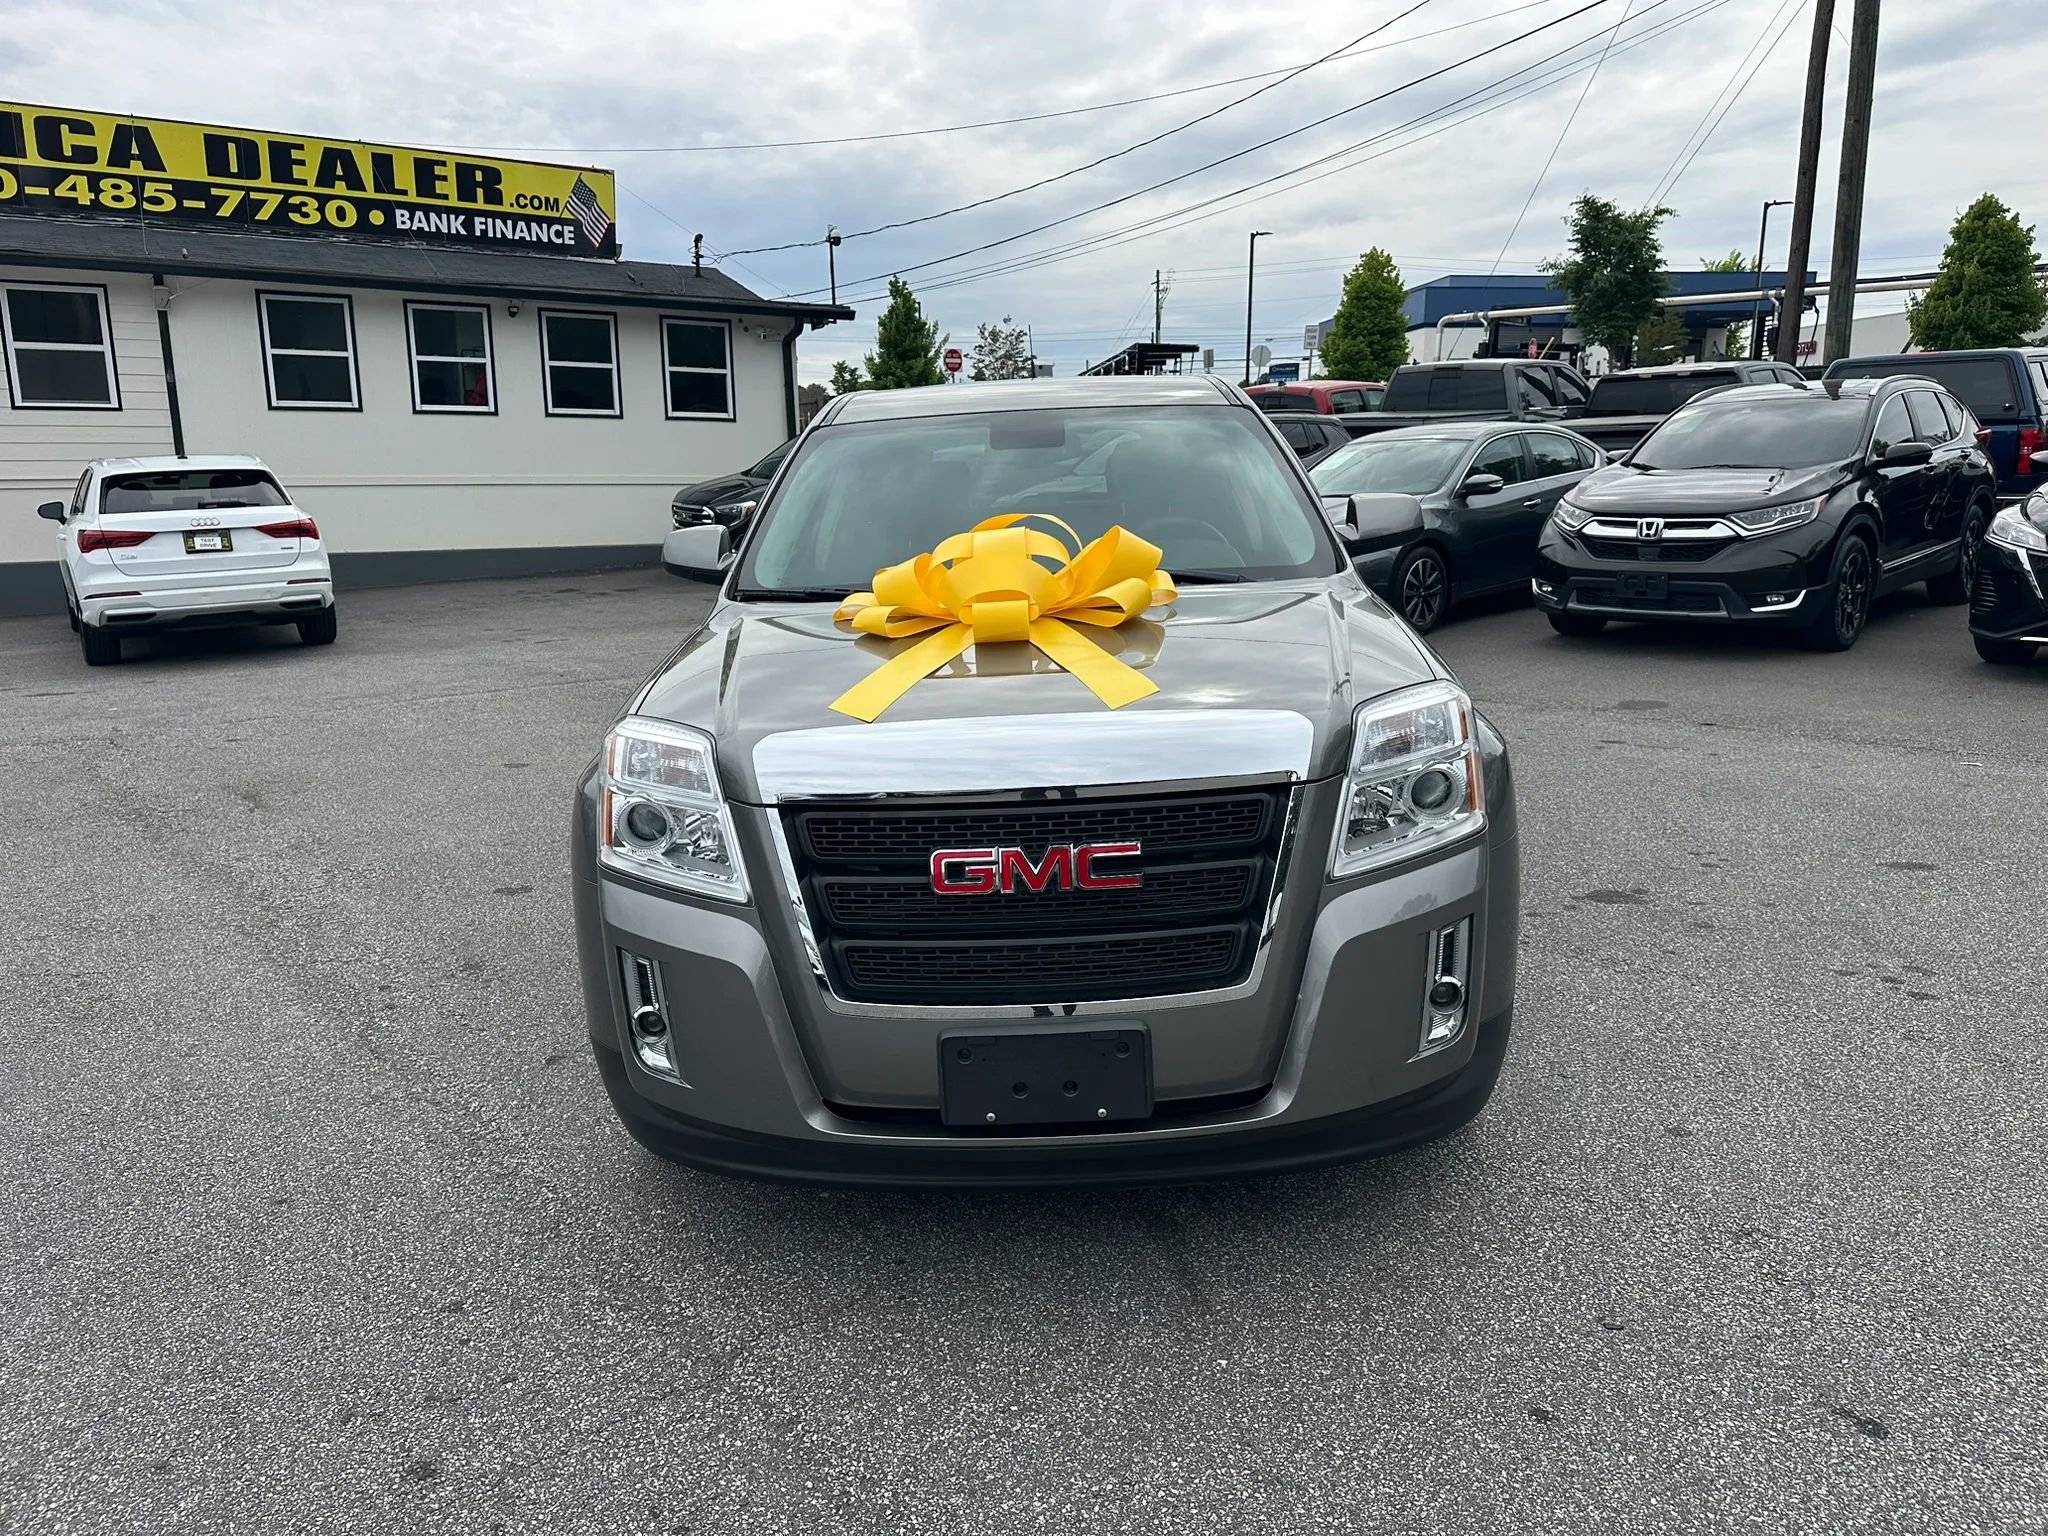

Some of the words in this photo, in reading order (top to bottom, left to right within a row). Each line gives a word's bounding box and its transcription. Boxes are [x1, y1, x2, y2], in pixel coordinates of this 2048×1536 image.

[395, 208, 467, 235] BANK
[474, 216, 575, 245] FINANCE
[930, 842, 1144, 895] GMC
